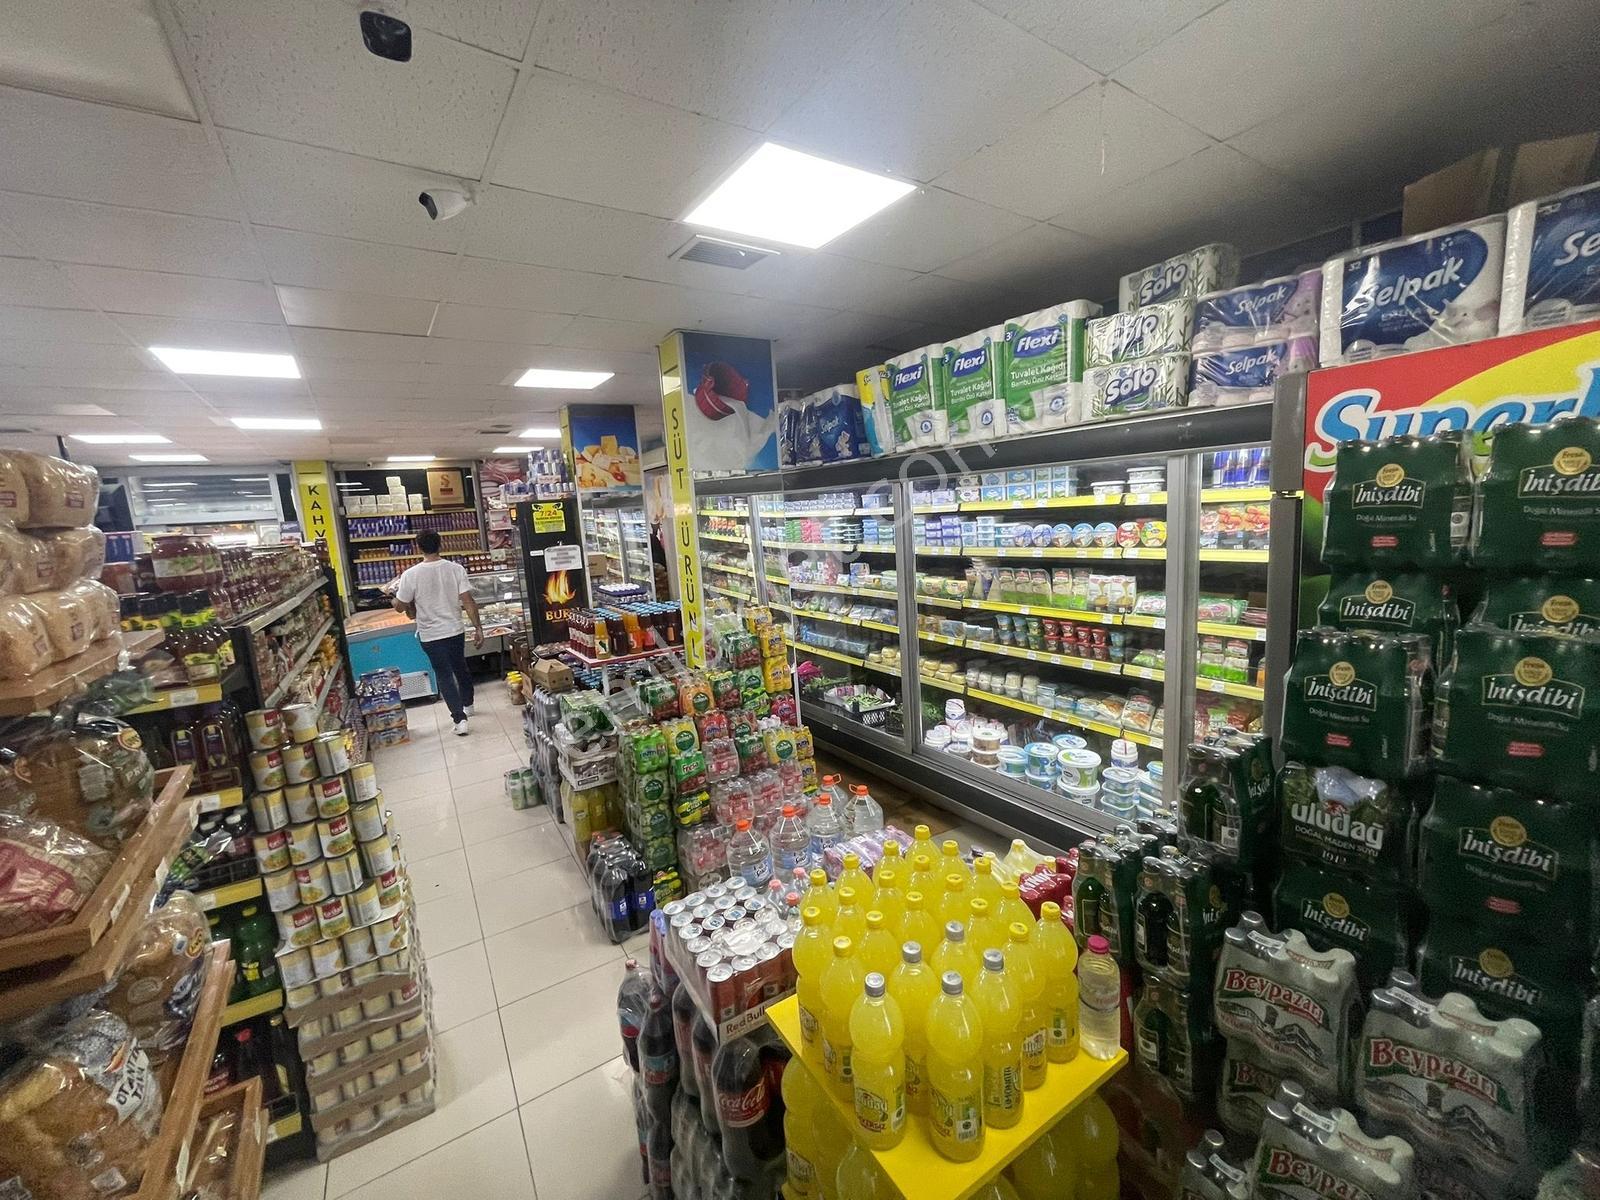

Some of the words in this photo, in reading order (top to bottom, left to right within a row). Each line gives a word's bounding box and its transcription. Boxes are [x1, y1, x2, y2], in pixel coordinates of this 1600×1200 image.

[1140, 263, 1188, 304] Solo
[1234, 285, 1286, 315] Selpak
[1357, 256, 1464, 314] Selpak
[1225, 348, 1278, 376] Selpak
[1105, 366, 1157, 403] Solo
[1355, 483, 1422, 505] İnişdibi
[672, 408, 685, 489] SÜT
[680, 522, 701, 667] ÜRÜNL
[1344, 597, 1411, 622] İnişdibi
[1307, 677, 1373, 705] İnişdibi
[1487, 677, 1579, 710] İnişdibi
[1291, 802, 1384, 851] uludağ
[1223, 967, 1324, 1024] Beypazarı
[725, 1018, 747, 1035] Red
[746, 1005, 766, 1023] Bull
[1369, 1037, 1498, 1101] Beypazarı
